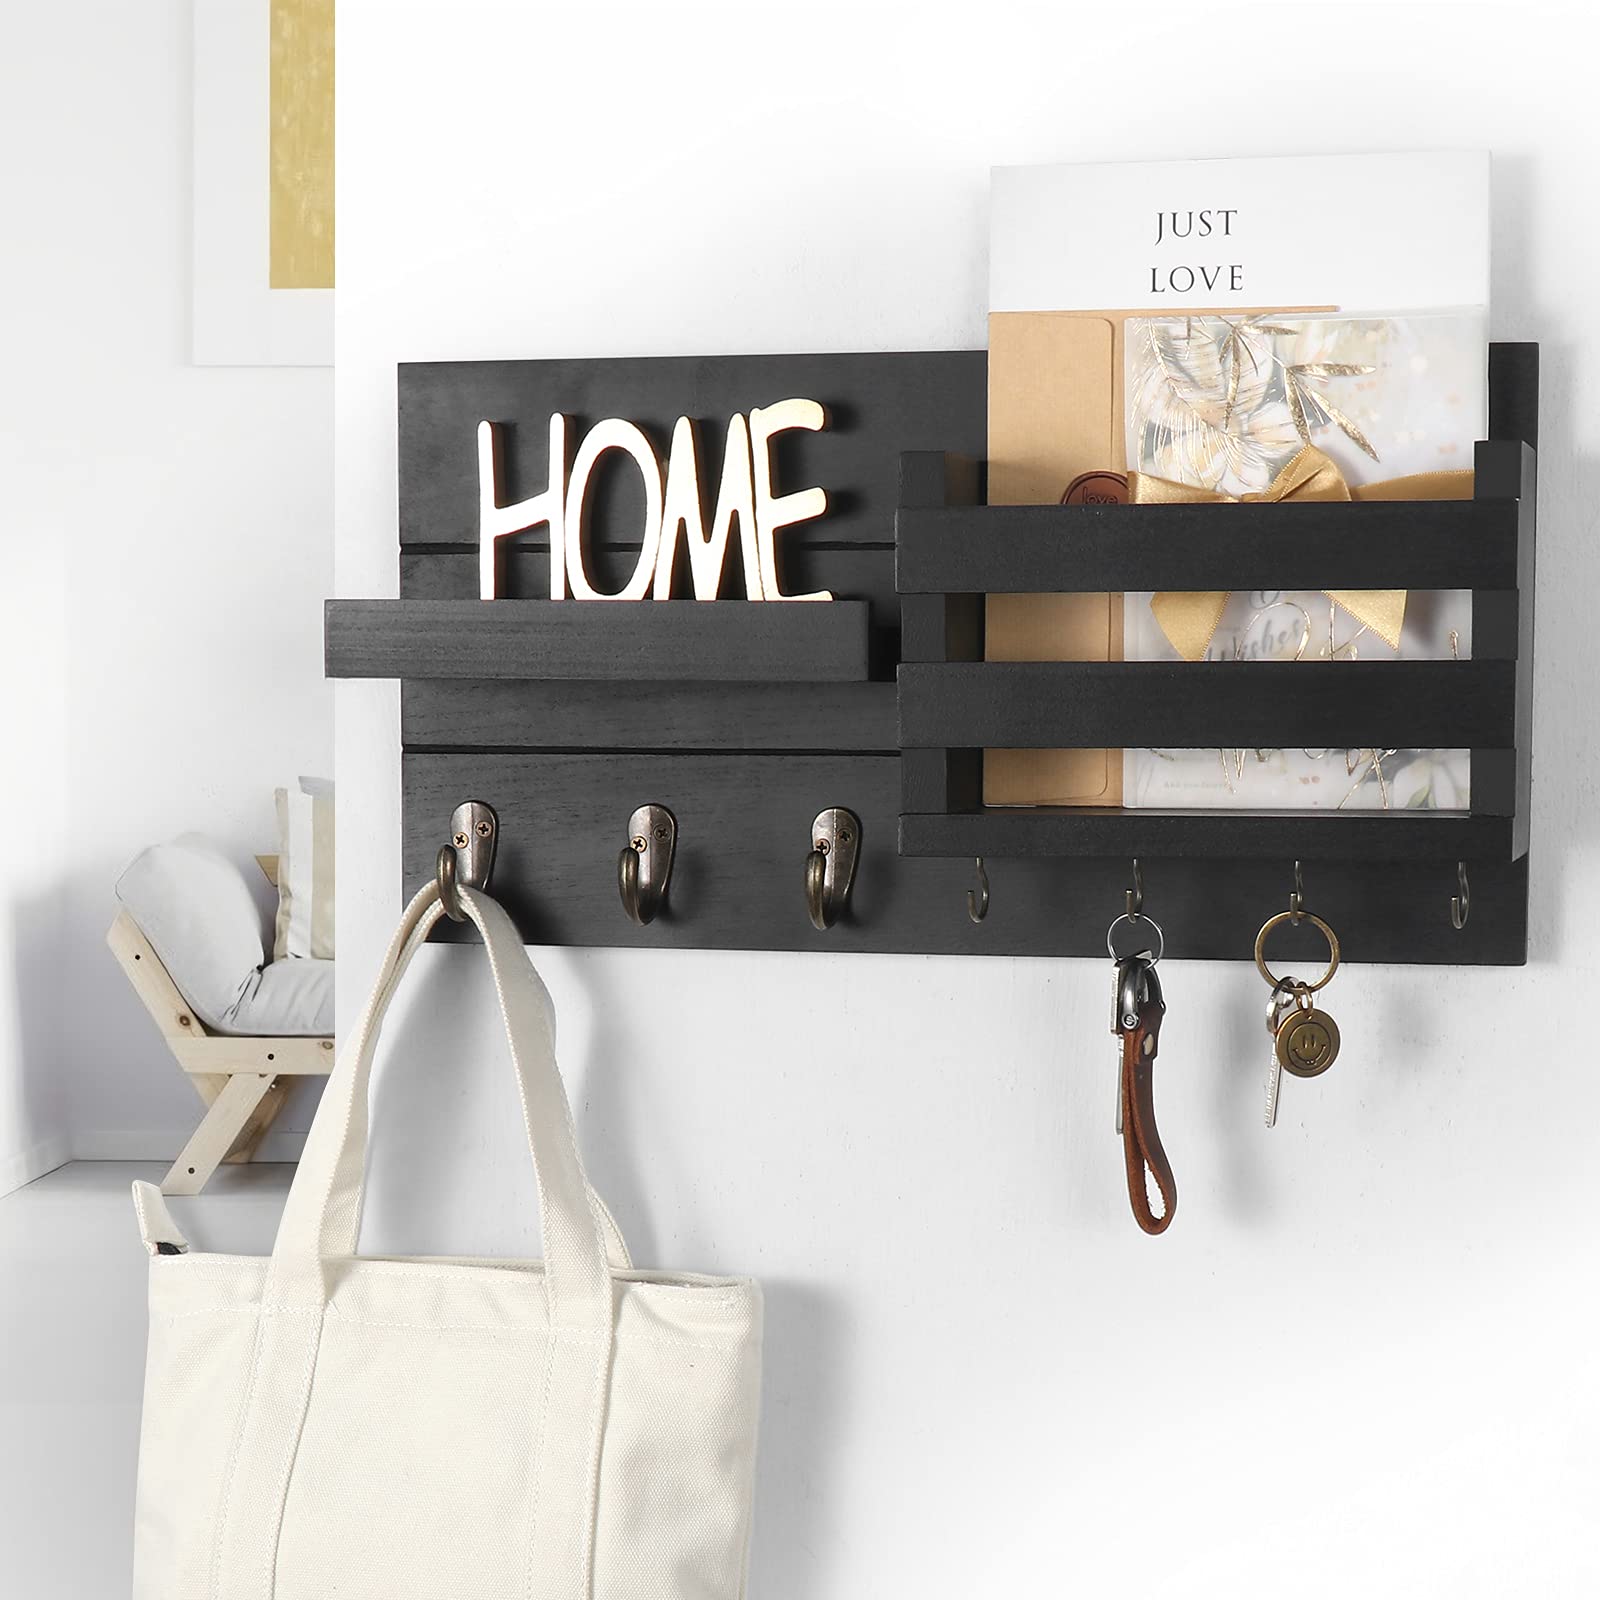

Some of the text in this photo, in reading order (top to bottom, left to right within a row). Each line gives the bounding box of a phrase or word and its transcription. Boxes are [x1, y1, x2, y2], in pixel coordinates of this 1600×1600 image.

[1154, 209, 1238, 246] JUST
[1150, 265, 1244, 293] LOVE
[477, 398, 833, 601] HOME
